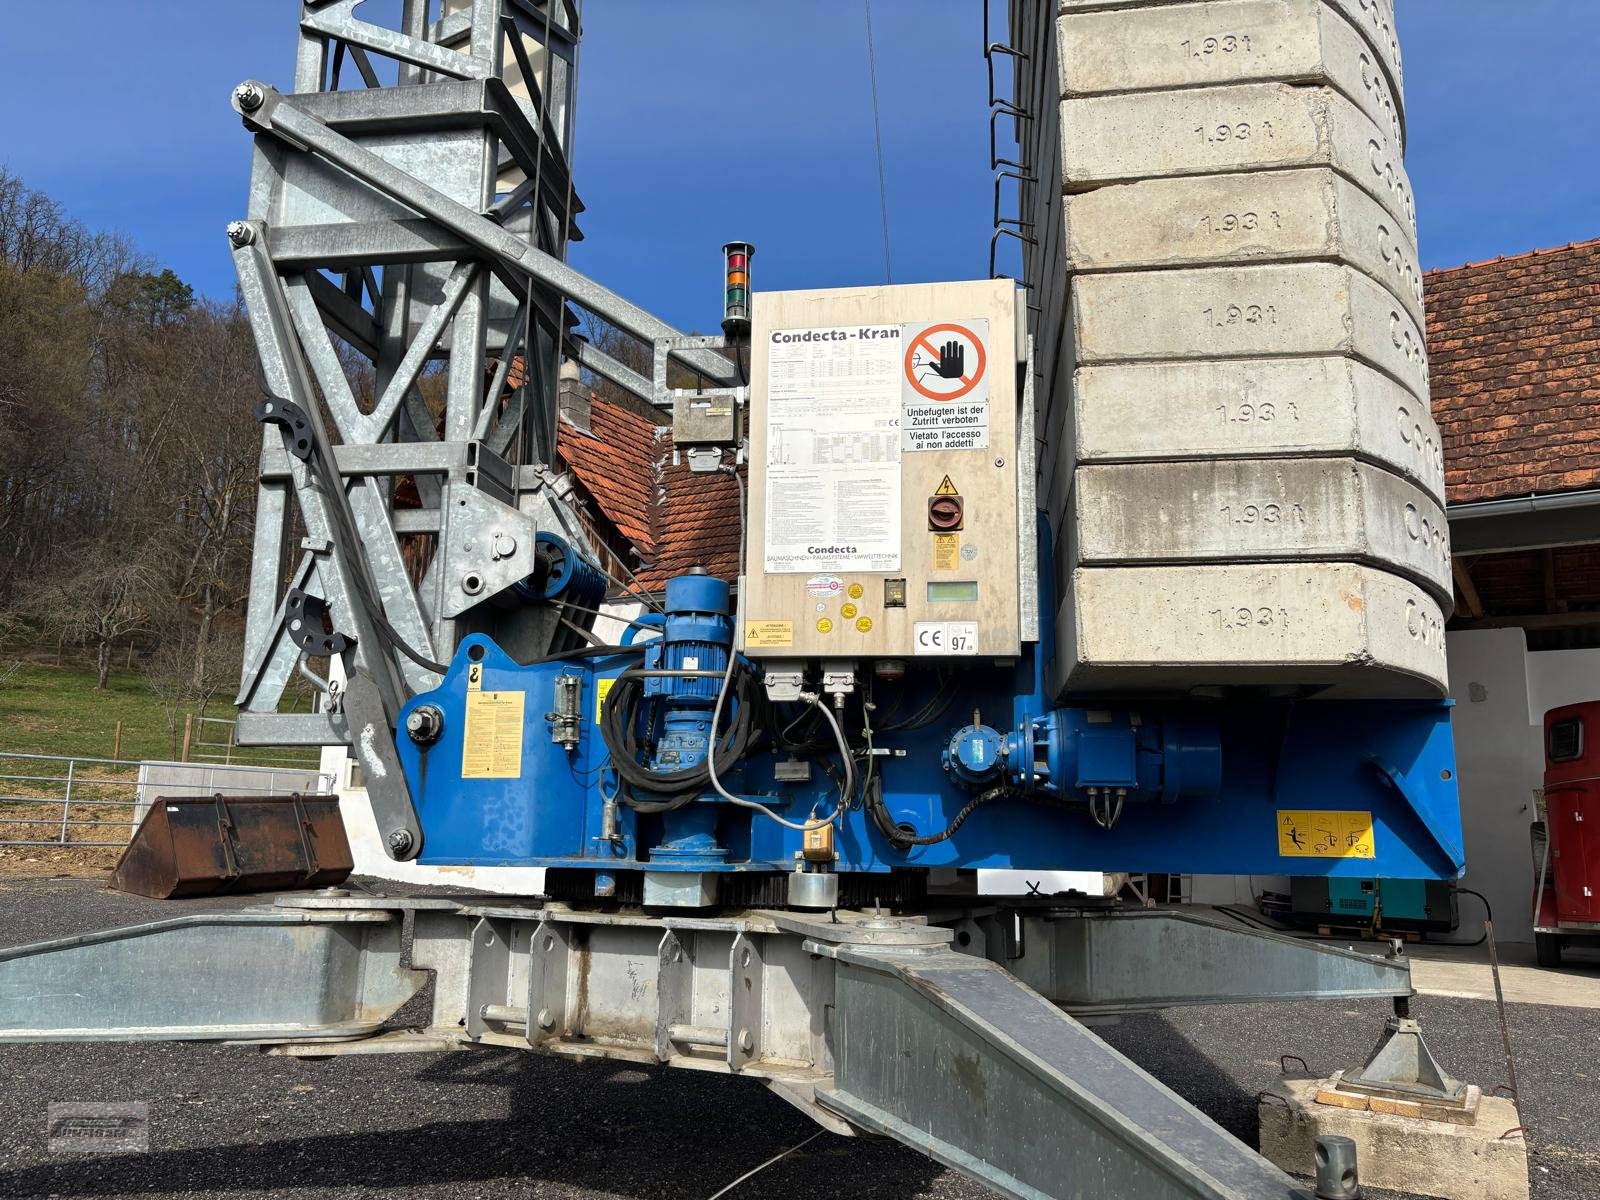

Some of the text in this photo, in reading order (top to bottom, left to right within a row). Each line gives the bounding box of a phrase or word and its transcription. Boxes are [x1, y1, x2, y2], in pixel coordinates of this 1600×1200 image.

[907, 405, 984, 418] Unbefugten ist der
[912, 415, 979, 426] Zutritt verboten
[910, 430, 981, 440] Vietato l'accesso
[916, 439, 974, 449] ai non addetti
[807, 546, 858, 555] Condecta
[919, 630, 942, 647] CE
[951, 637, 967, 651] 97
